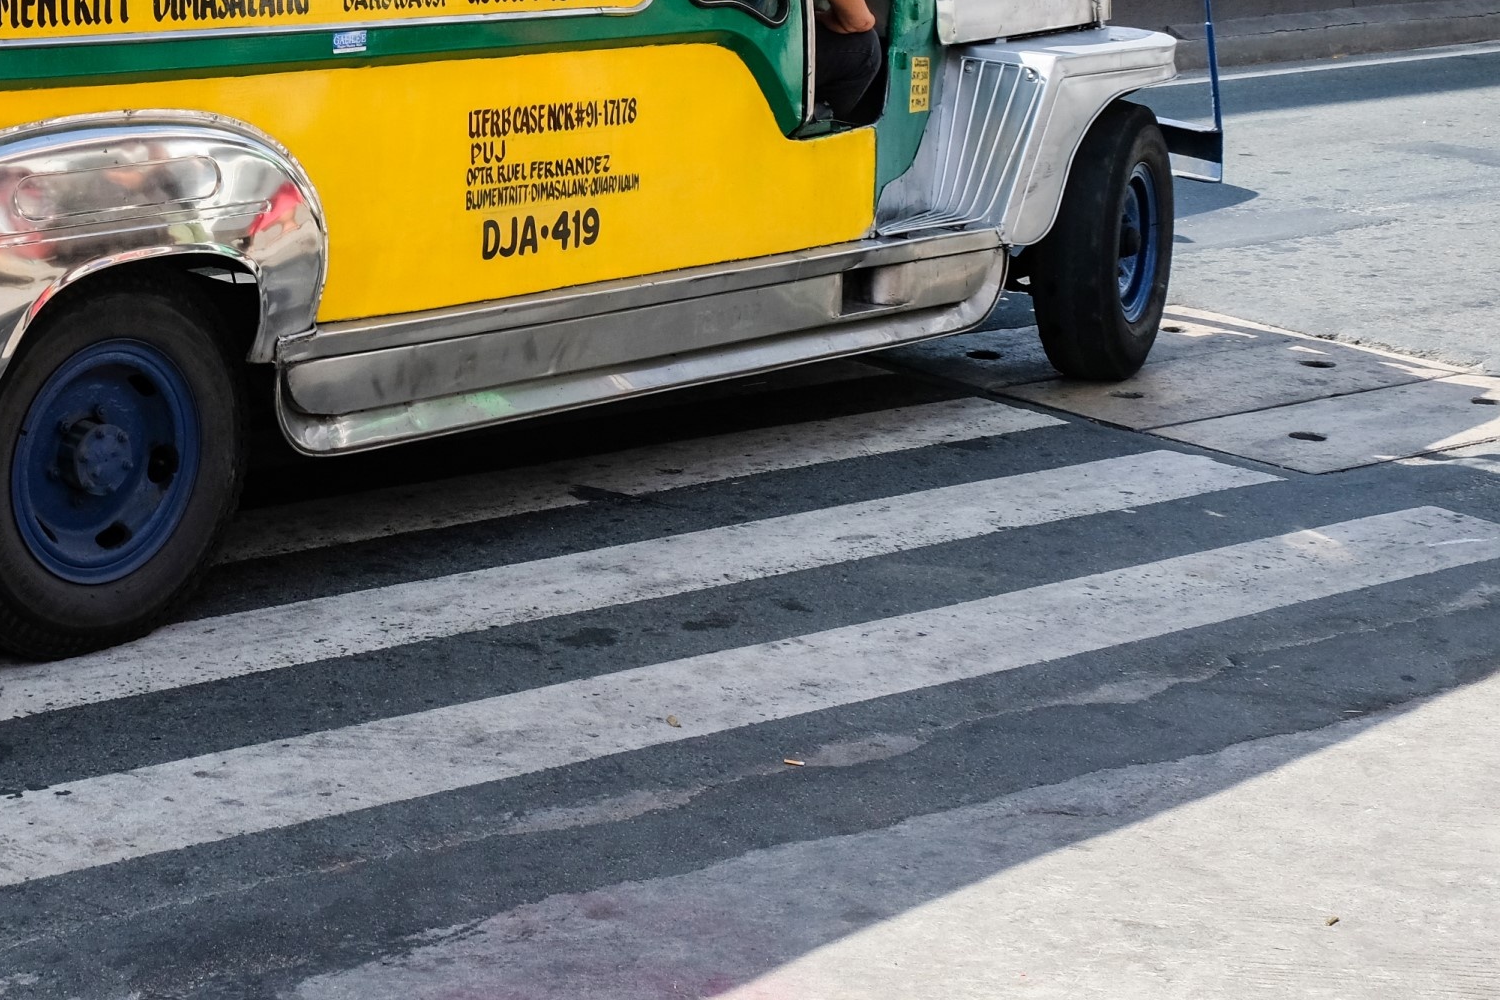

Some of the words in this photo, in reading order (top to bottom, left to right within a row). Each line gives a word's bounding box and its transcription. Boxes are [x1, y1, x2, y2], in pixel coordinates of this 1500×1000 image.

[468, 106, 511, 138] LTFRB
[512, 104, 546, 135] CASE
[547, 103, 575, 132] NCR
[471, 140, 506, 165] PUJ
[497, 163, 527, 184] RUEL
[530, 155, 611, 180] FERNANDEZ
